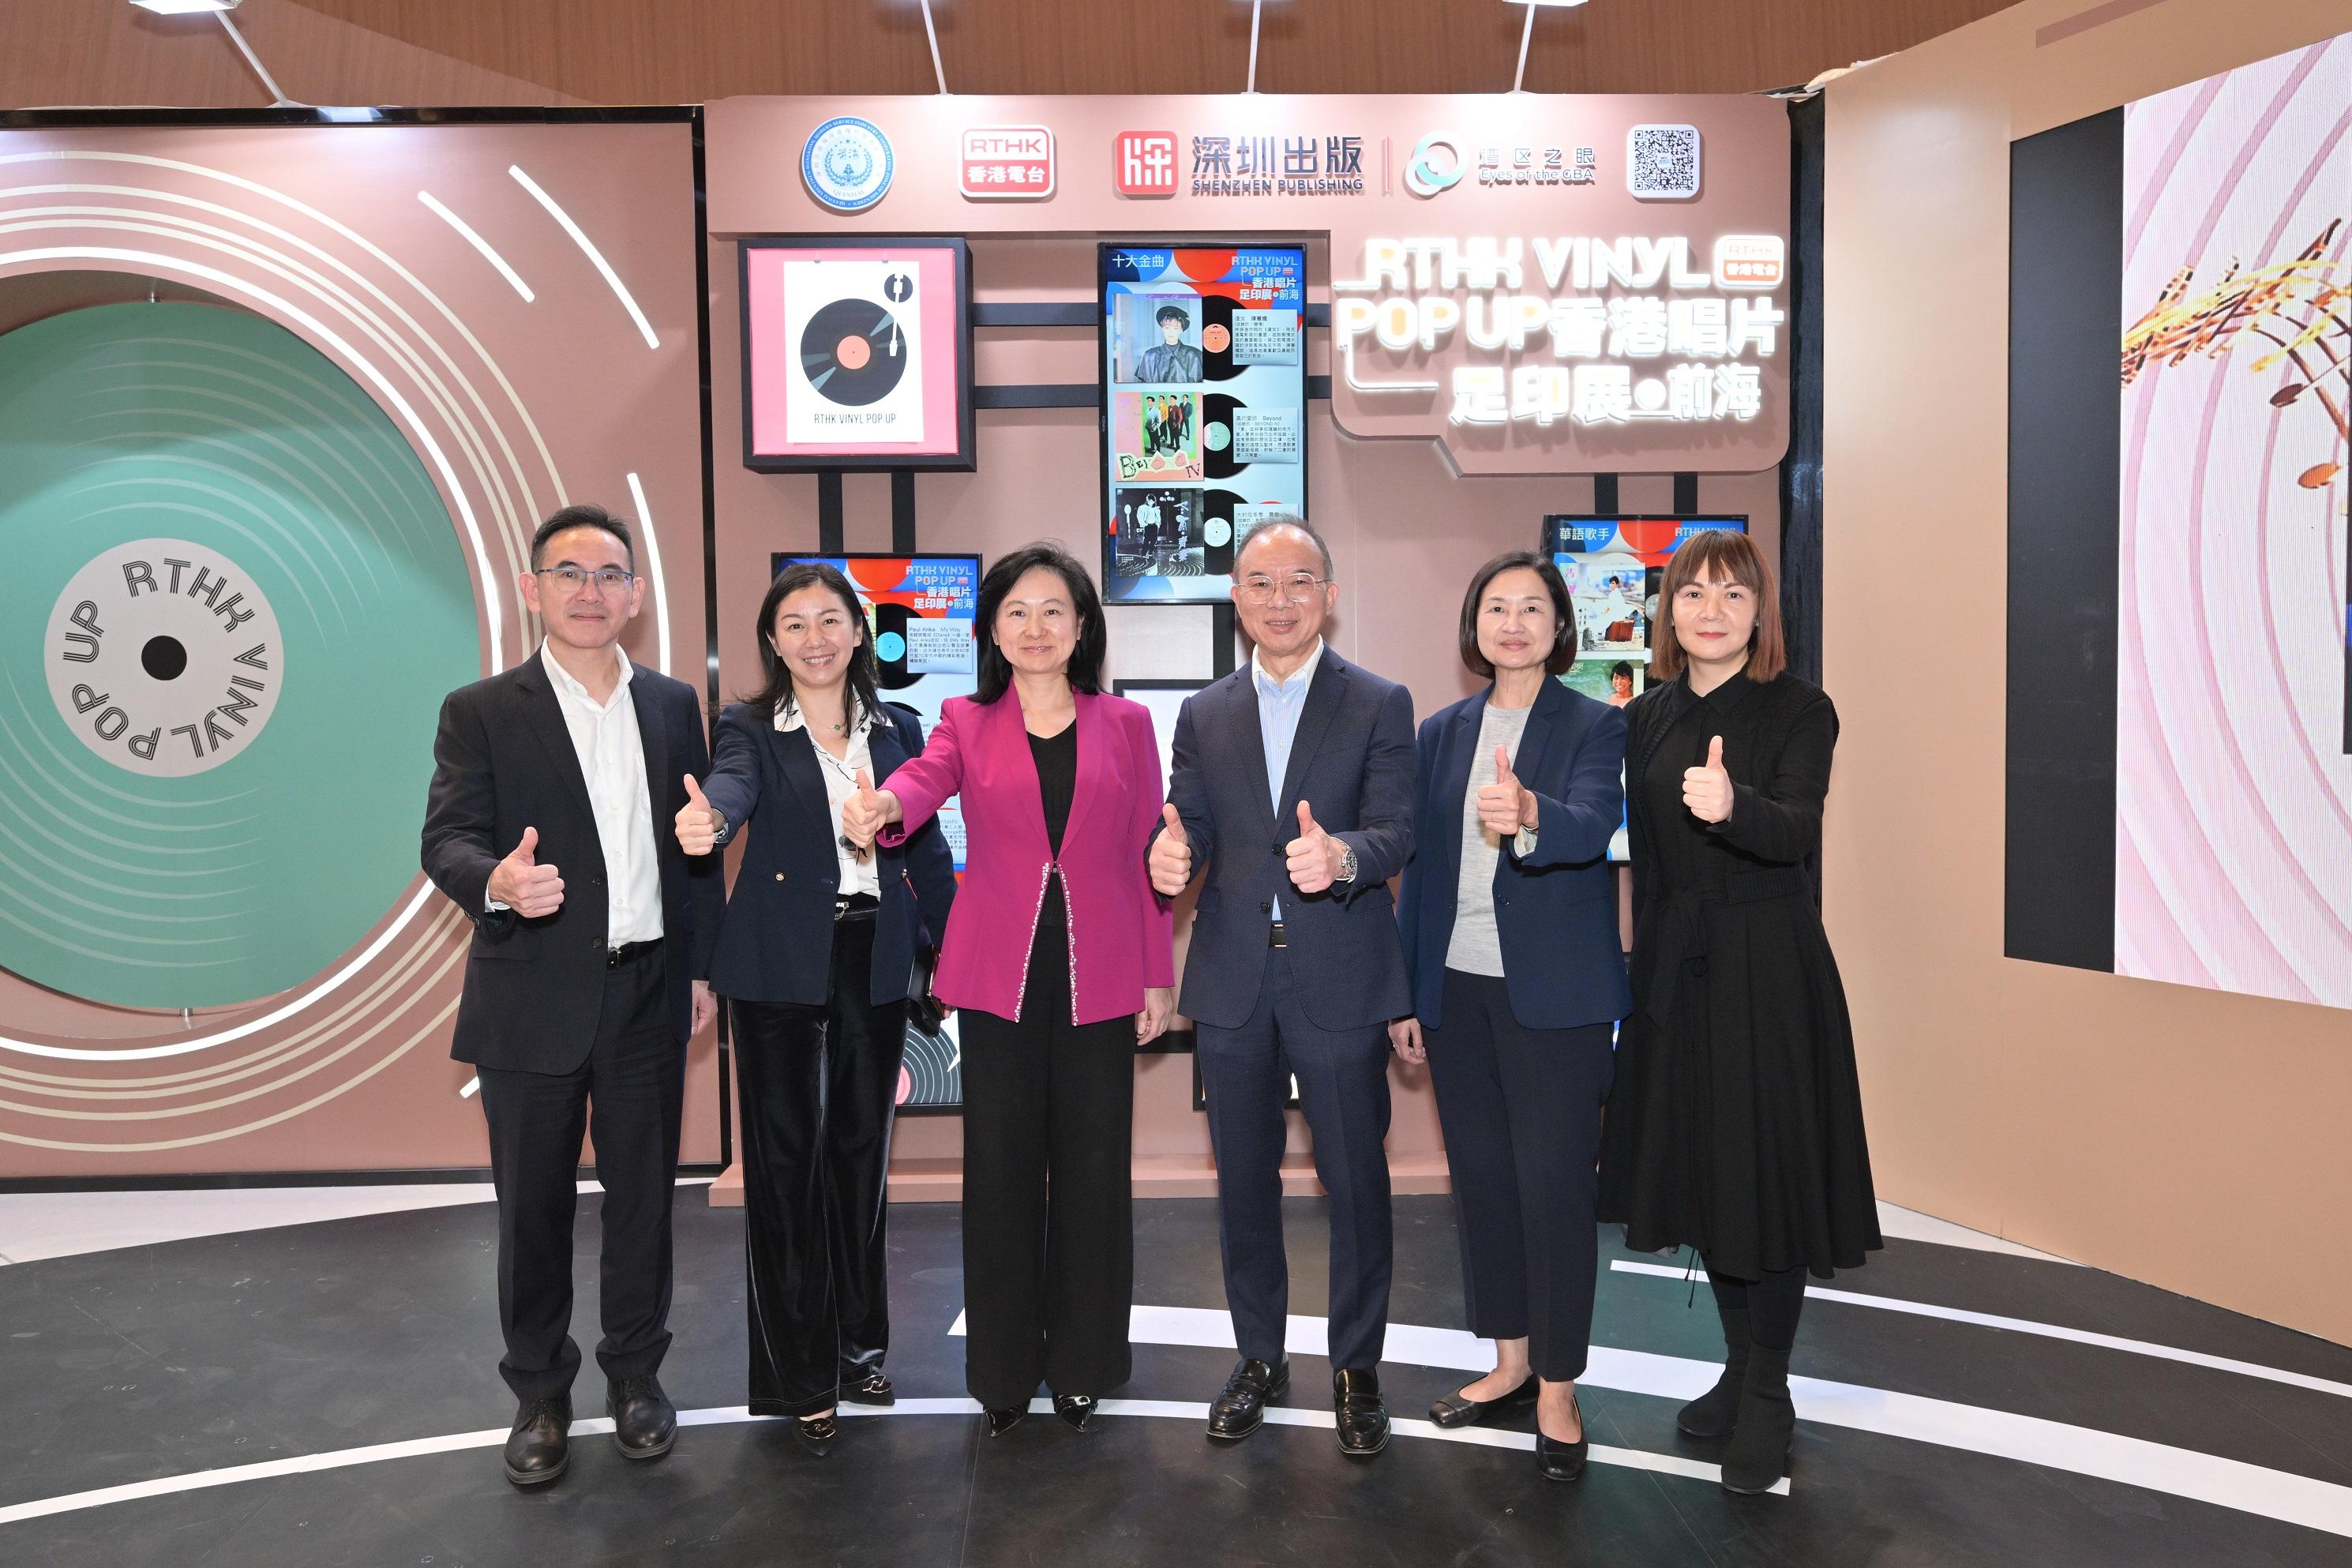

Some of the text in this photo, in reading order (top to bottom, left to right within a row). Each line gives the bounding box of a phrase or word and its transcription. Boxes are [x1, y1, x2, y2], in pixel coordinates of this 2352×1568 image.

[970, 138, 1041, 152] RTHK
[1193, 136, 1362, 174] 深圳出版
[1480, 148, 1594, 164] 湾区之眼
[967, 165, 1045, 183] 香港電台
[1480, 168, 1594, 182] Eyes of the GBA
[1193, 178, 1363, 190] SHENZHEN PUBLISHING
[1112, 254, 1165, 268] 十大金曲
[1232, 256, 1298, 265] RTHK VINYL
[1334, 237, 1711, 289] RTHK VINYL
[1240, 266, 1264, 276] POP
[1266, 266, 1281, 276] UP
[1252, 277, 1297, 288] 香港唱片
[1337, 298, 1460, 350] POP
[814, 414, 896, 424] RTHK VINYL POP UP
[1559, 527, 1610, 541] 華語歌手
[906, 565, 973, 576] RTHK VINYL
[915, 576, 939, 585] POP
[940, 576, 956, 585] UP
[926, 586, 971, 598] 香港唱片
[63, 557, 268, 760] RTHK VINYL POP UP
